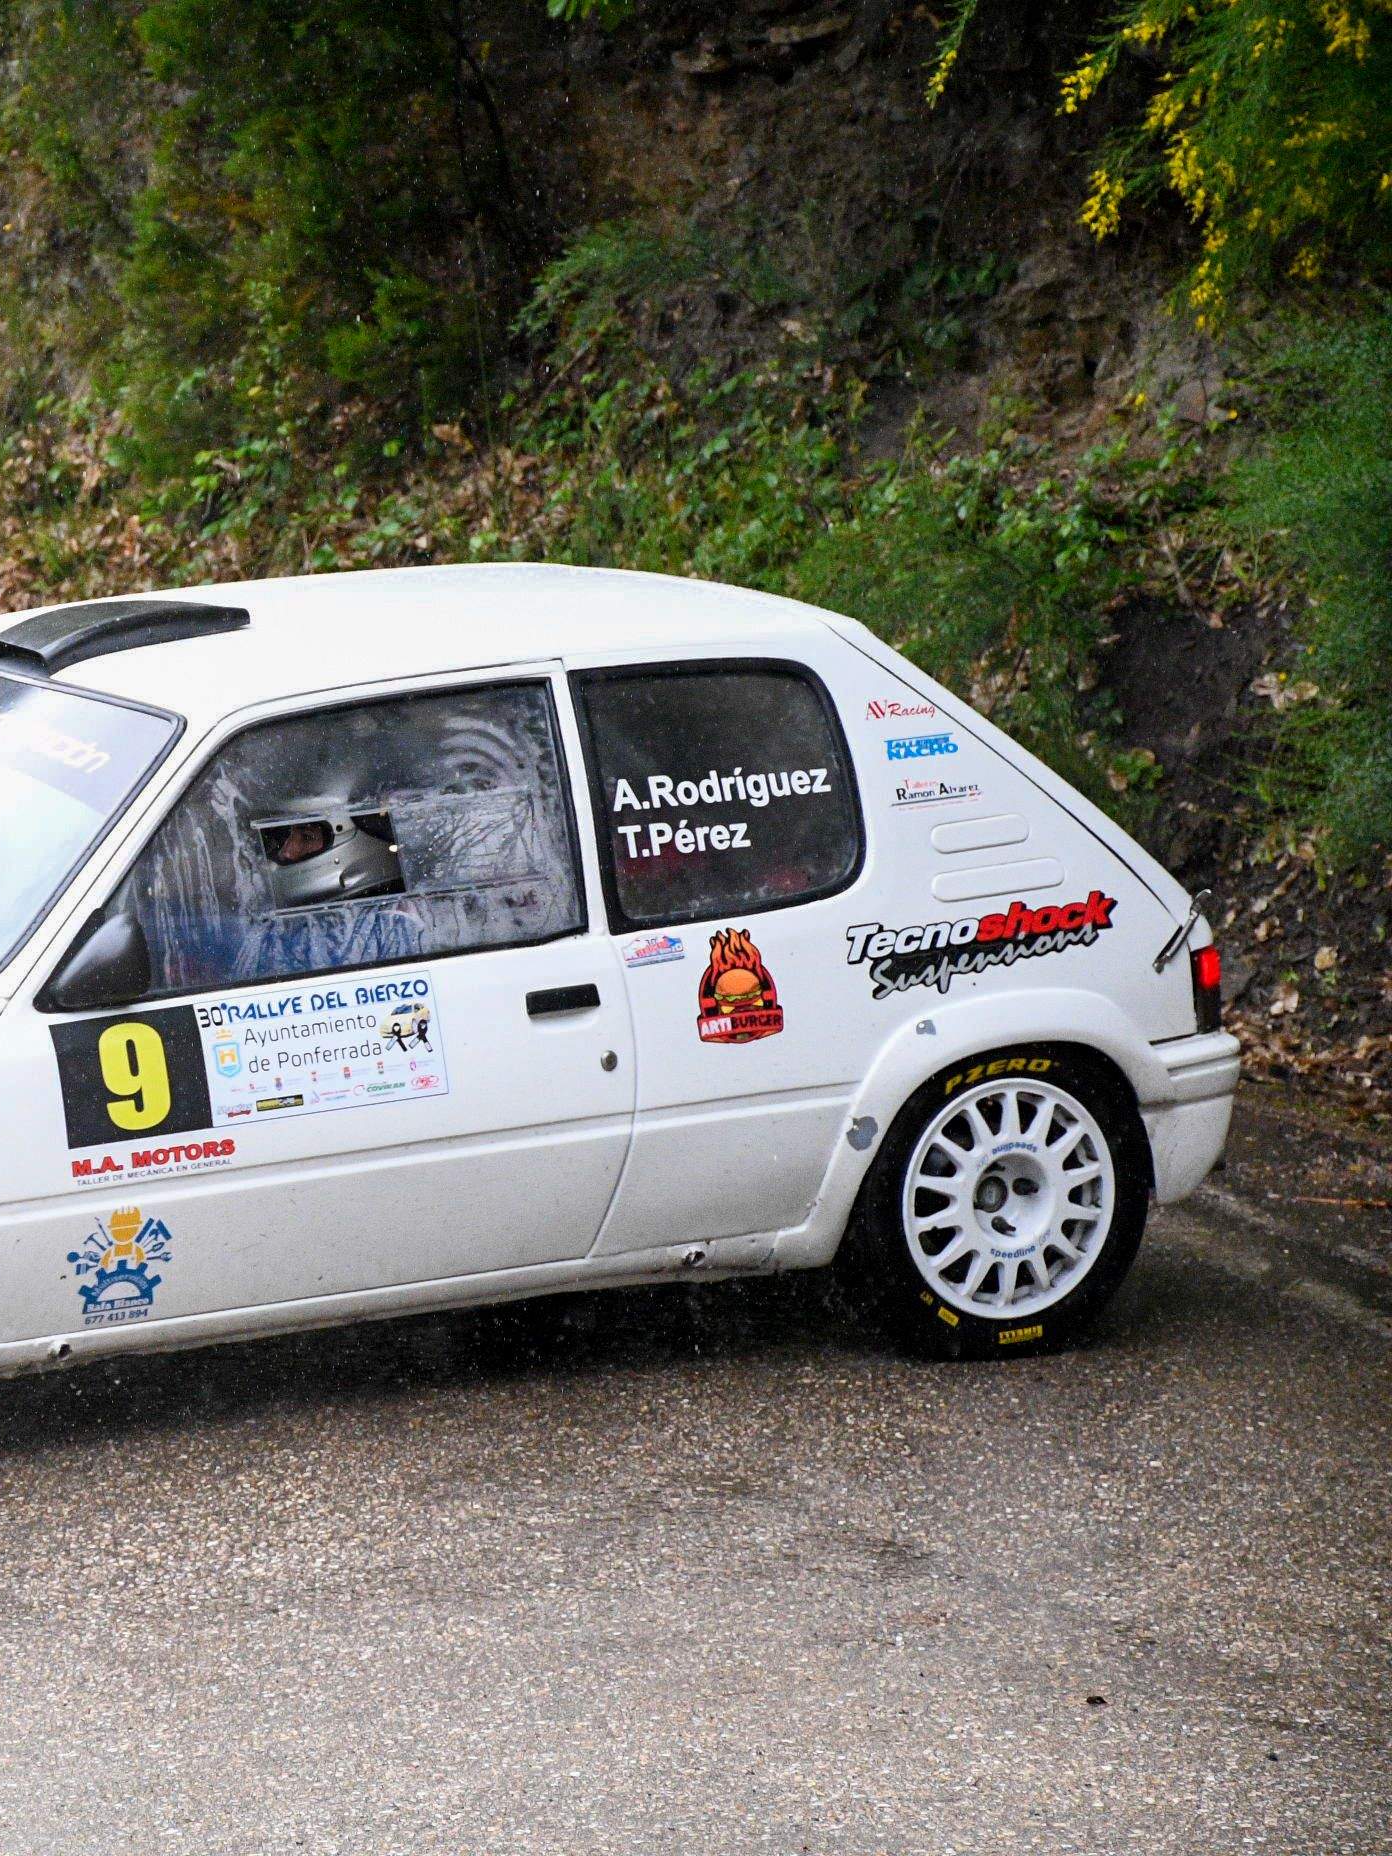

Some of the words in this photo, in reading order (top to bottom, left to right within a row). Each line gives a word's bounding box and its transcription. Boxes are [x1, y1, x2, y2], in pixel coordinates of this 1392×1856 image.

[888, 703, 935, 719] Racing
[613, 767, 832, 812] A.Rodríguez
[617, 819, 752, 858] T.Pérez
[227, 996, 302, 1024] RALLYE
[311, 991, 348, 1012] DEL
[356, 979, 429, 1004] BIERZO
[244, 1013, 377, 1047] Ayuntamiento
[248, 1056, 270, 1074] de
[277, 1040, 383, 1069] Ponferrada
[98, 1022, 171, 1131] 9
[72, 1156, 123, 1177] M.A.
[132, 1139, 235, 1168] MOTORS
[77, 1175, 111, 1186] TALLER
[113, 1172, 126, 1181] DE
[176, 1163, 188, 1172] EN
[191, 1158, 233, 1170] GENERAL
[990, 1245, 1037, 1259] speedline
